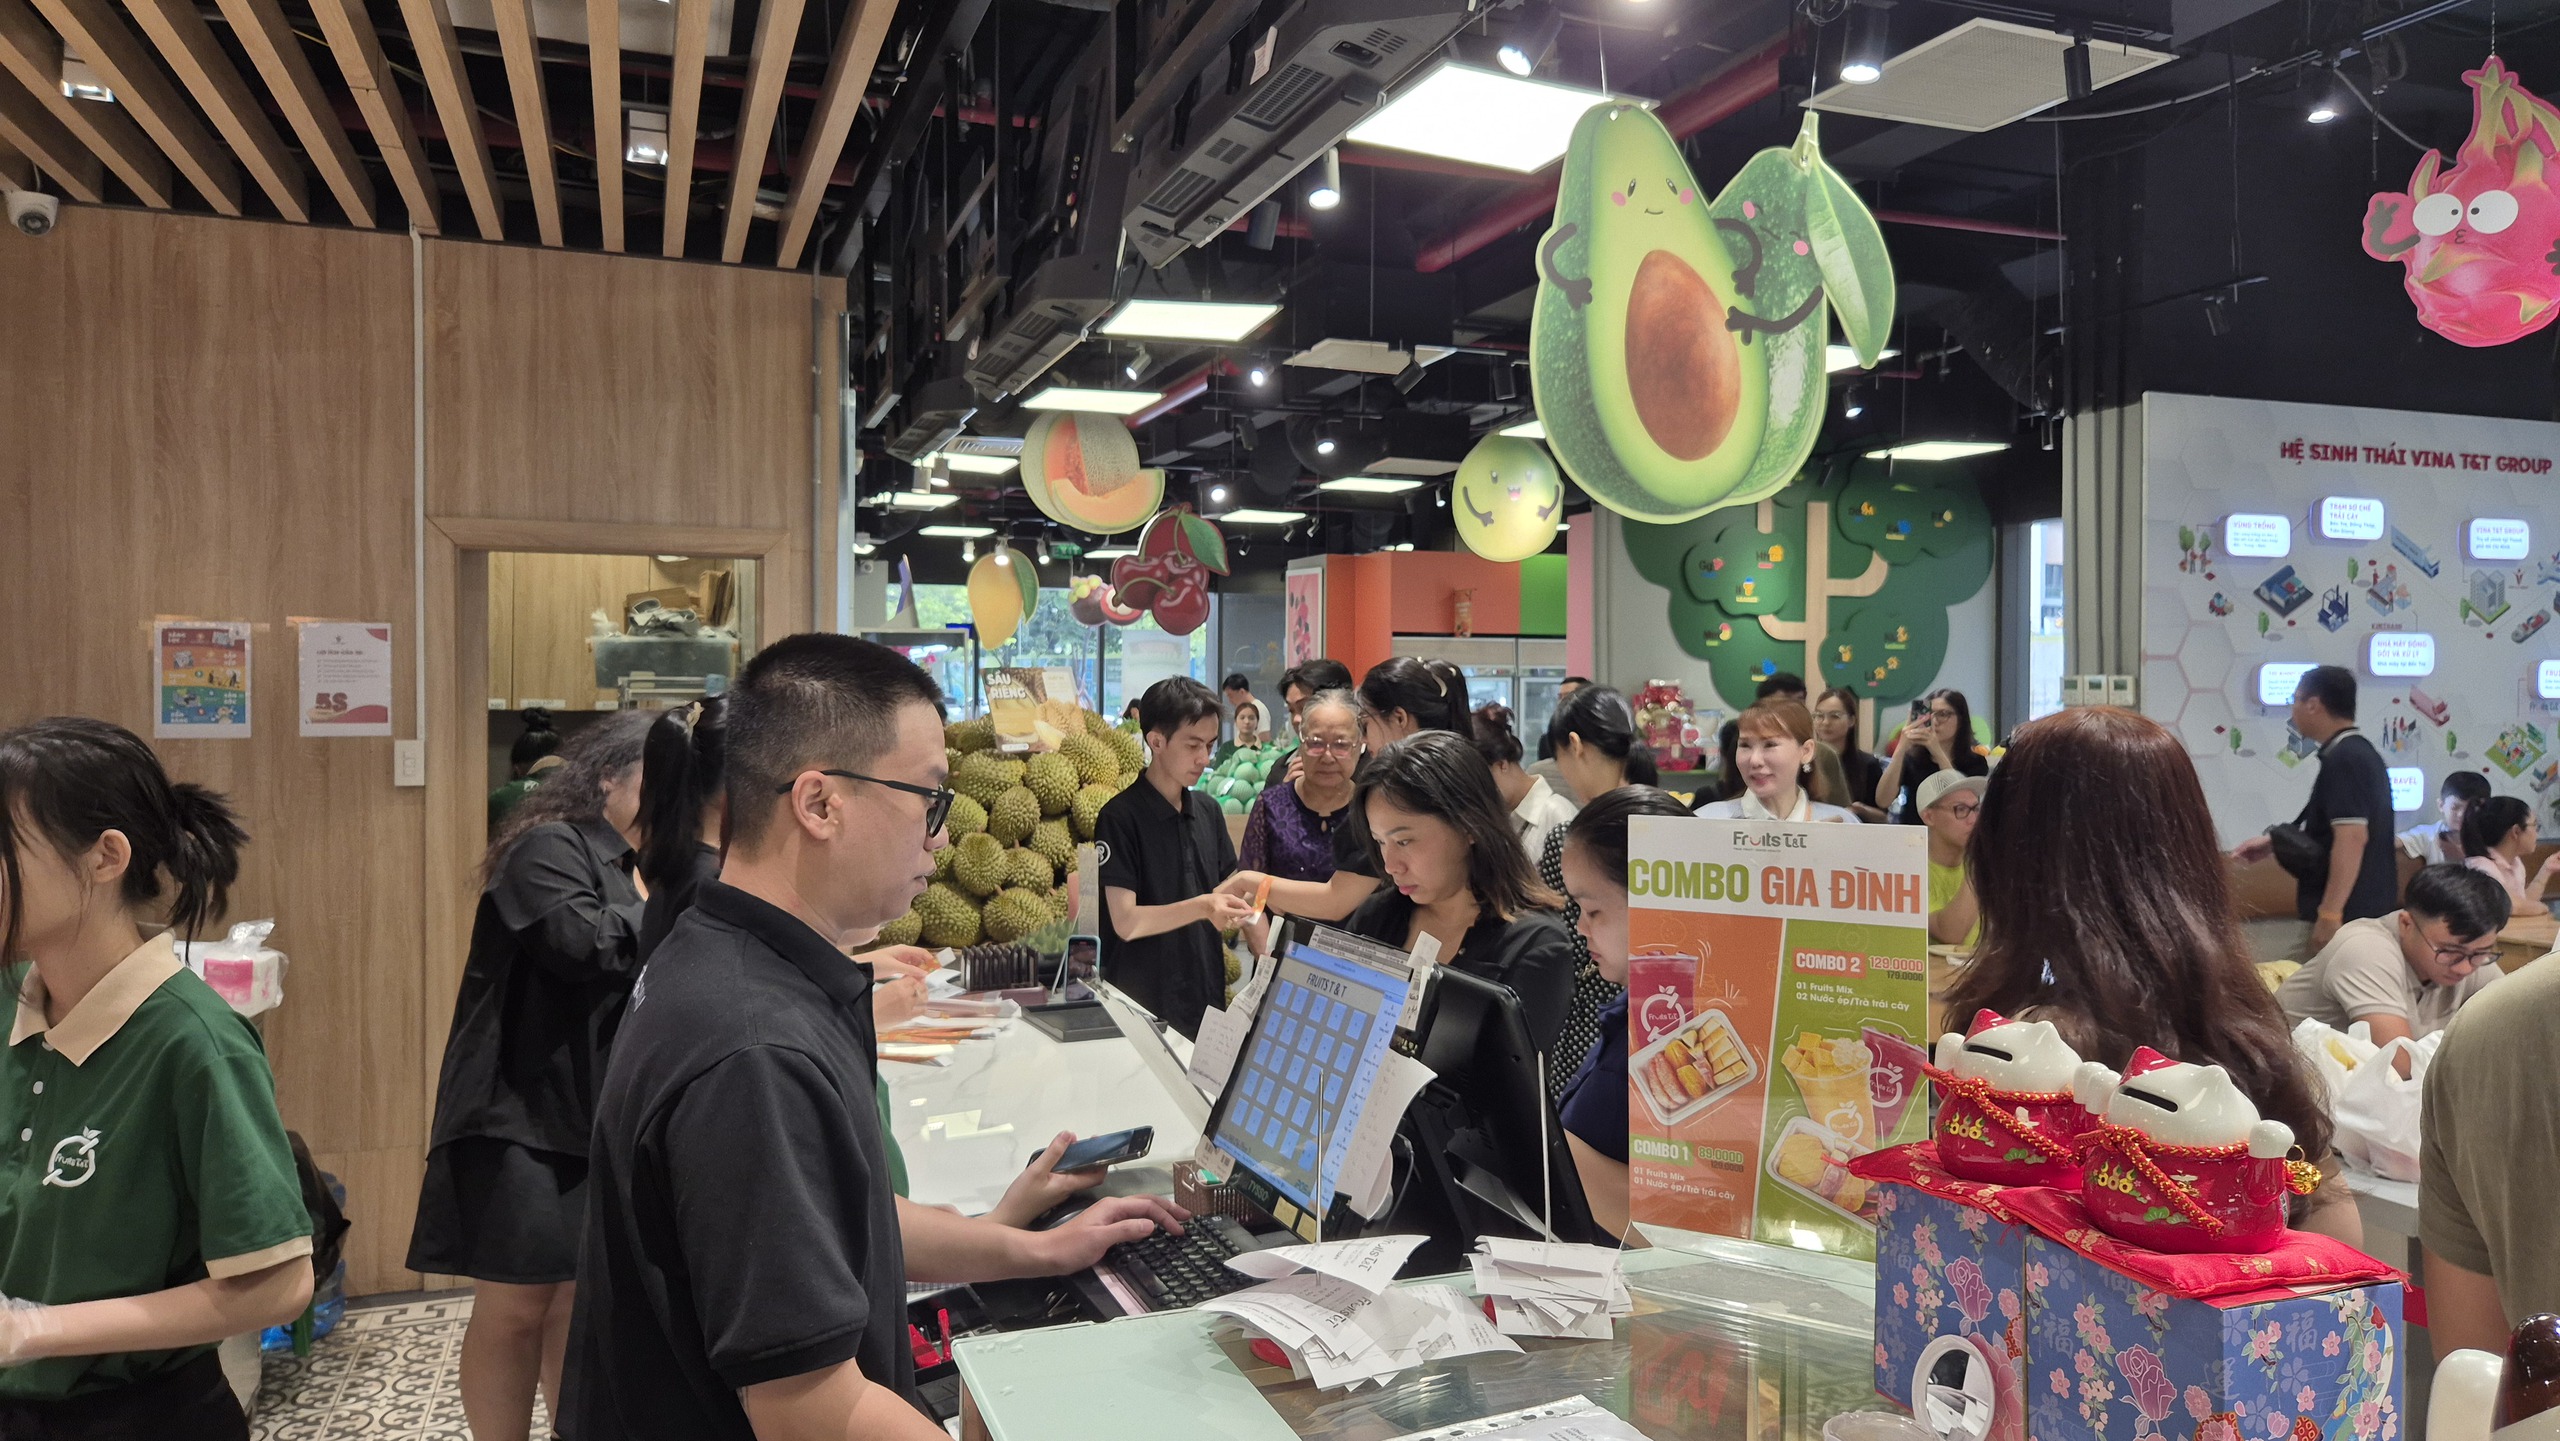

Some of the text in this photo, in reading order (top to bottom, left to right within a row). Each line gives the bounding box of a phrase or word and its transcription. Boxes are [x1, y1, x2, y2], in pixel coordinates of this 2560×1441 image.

[2280, 437, 2553, 475] HỆ SINH THÁI VINA T&T GROUP
[315, 692, 348, 712] 5S
[1733, 830, 1808, 849] Fruits T&T
[1628, 858, 1921, 915] COMBO GIA ĐÌNH
[1796, 952, 1847, 972] COMBO
[1850, 957, 1861, 973] 2
[1796, 981, 1853, 995] 01 Fruits Mix
[1796, 992, 1910, 1012] 02 Nước ép/Trà trái cây
[1633, 1139, 1679, 1160] COMBO
[1681, 1146, 1689, 1161] 1
[1633, 1166, 1685, 1182] 01 Fruits Mix
[1633, 1176, 1644, 1185] 01
[1718, 1191, 1736, 1202] cây
[2285, 1309, 2318, 1353] 福
